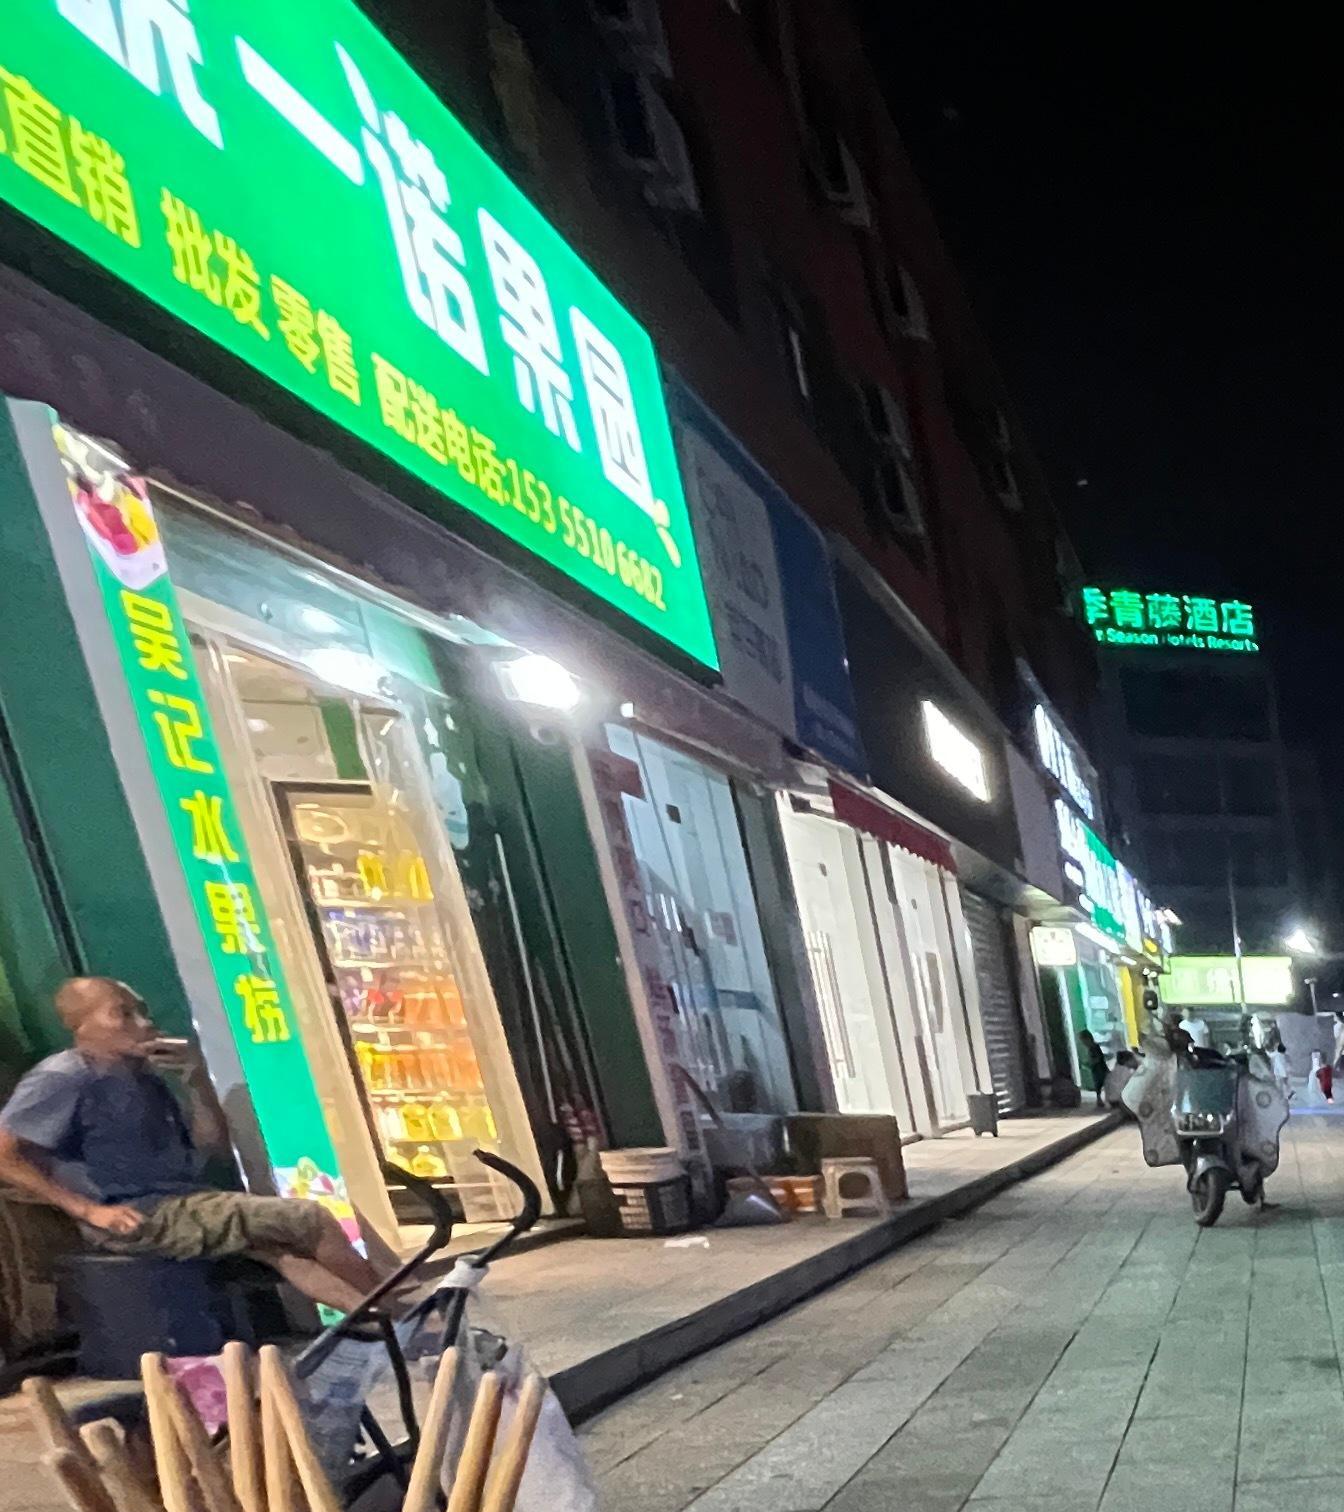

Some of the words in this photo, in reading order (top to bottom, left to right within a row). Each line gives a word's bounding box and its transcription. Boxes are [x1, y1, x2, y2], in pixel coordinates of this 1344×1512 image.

[0, 65, 141, 248] 直销
[161, 186, 270, 340] 批发
[270, 274, 361, 406] 零售
[120, 588, 291, 1043] 吴记水果捞
